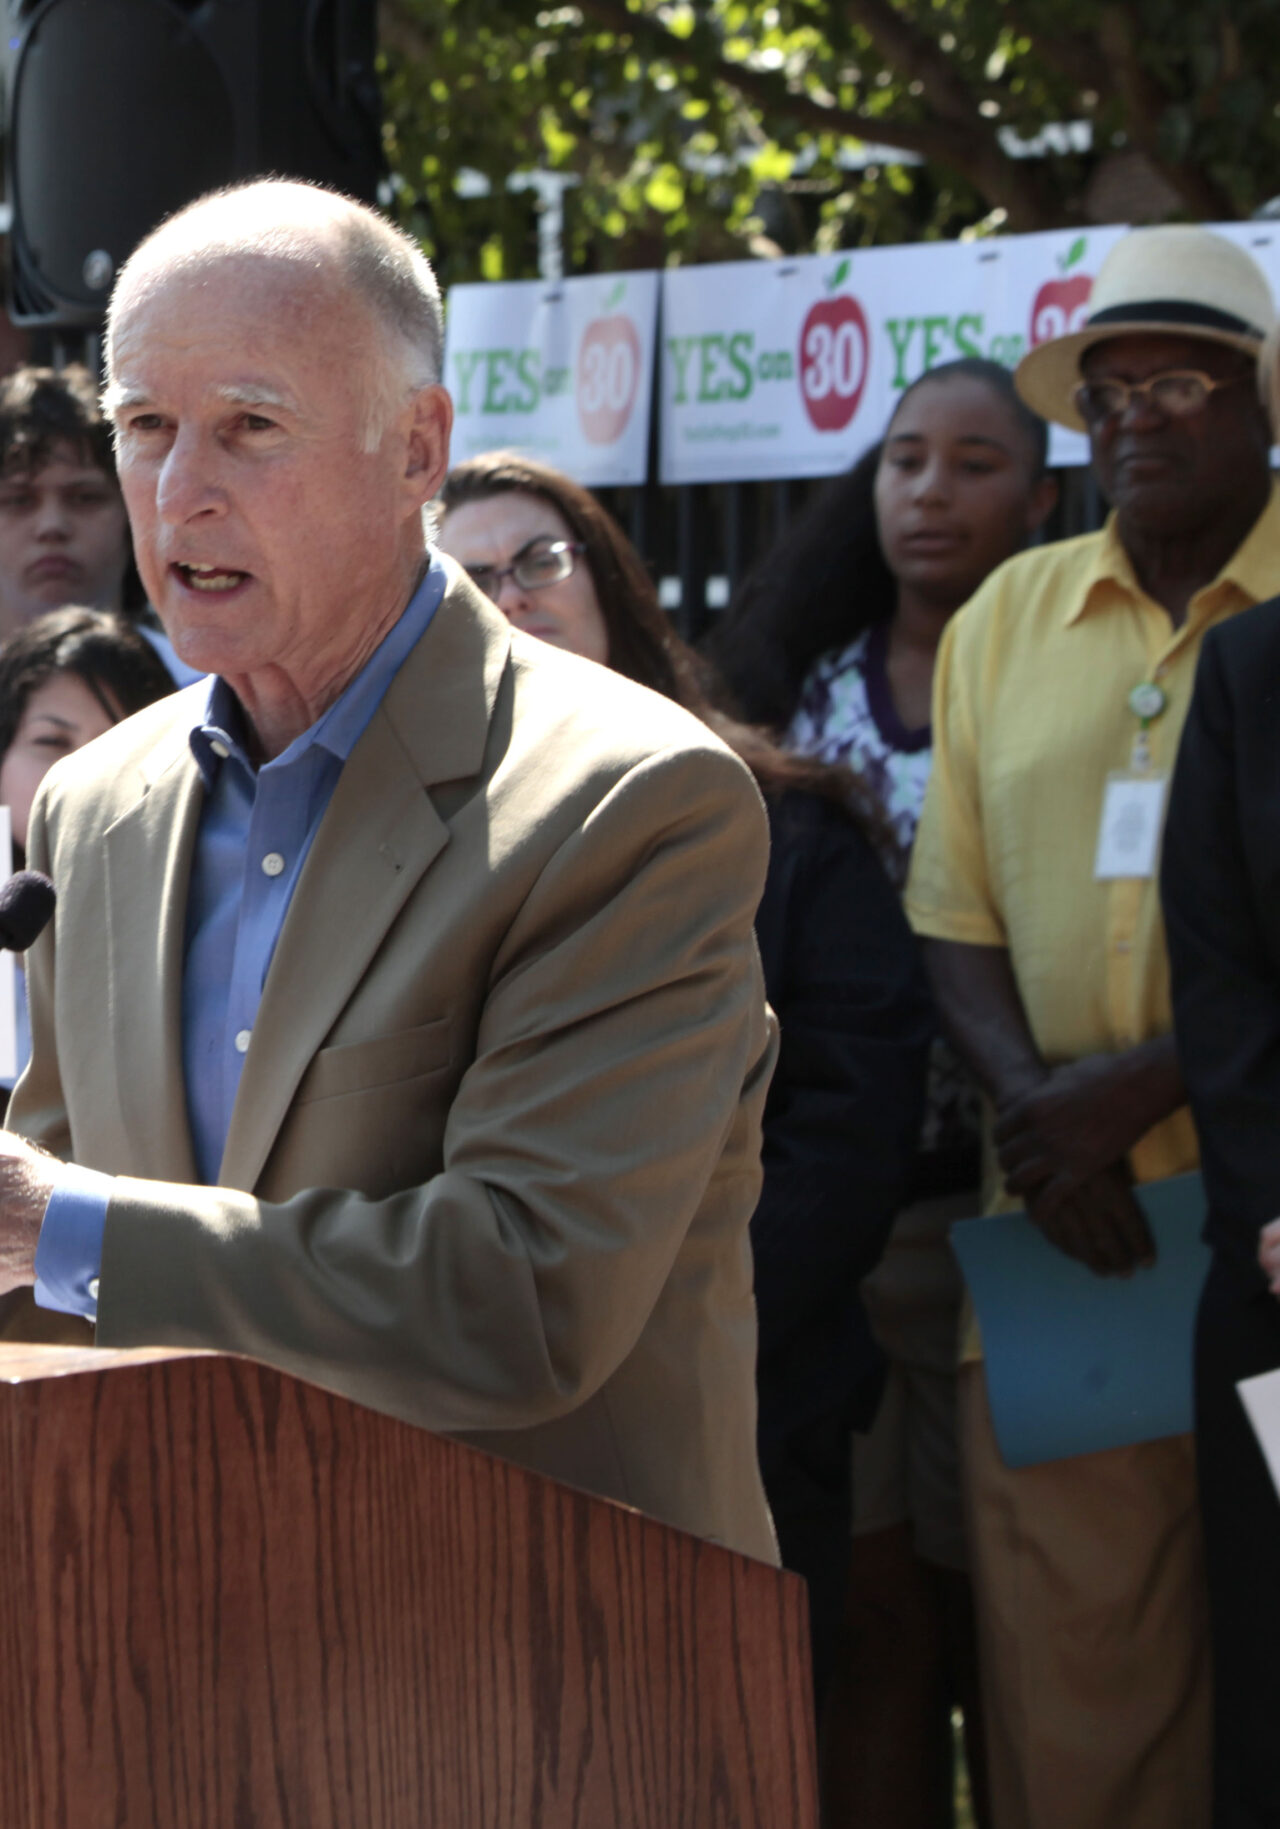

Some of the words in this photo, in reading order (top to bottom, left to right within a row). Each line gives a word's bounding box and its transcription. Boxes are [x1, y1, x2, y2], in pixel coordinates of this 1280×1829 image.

[452, 347, 541, 415] YES
[581, 341, 634, 412] 30
[668, 331, 754, 405] YES
[758, 351, 794, 380] on
[805, 321, 865, 400] 30
[885, 313, 983, 389] YES
